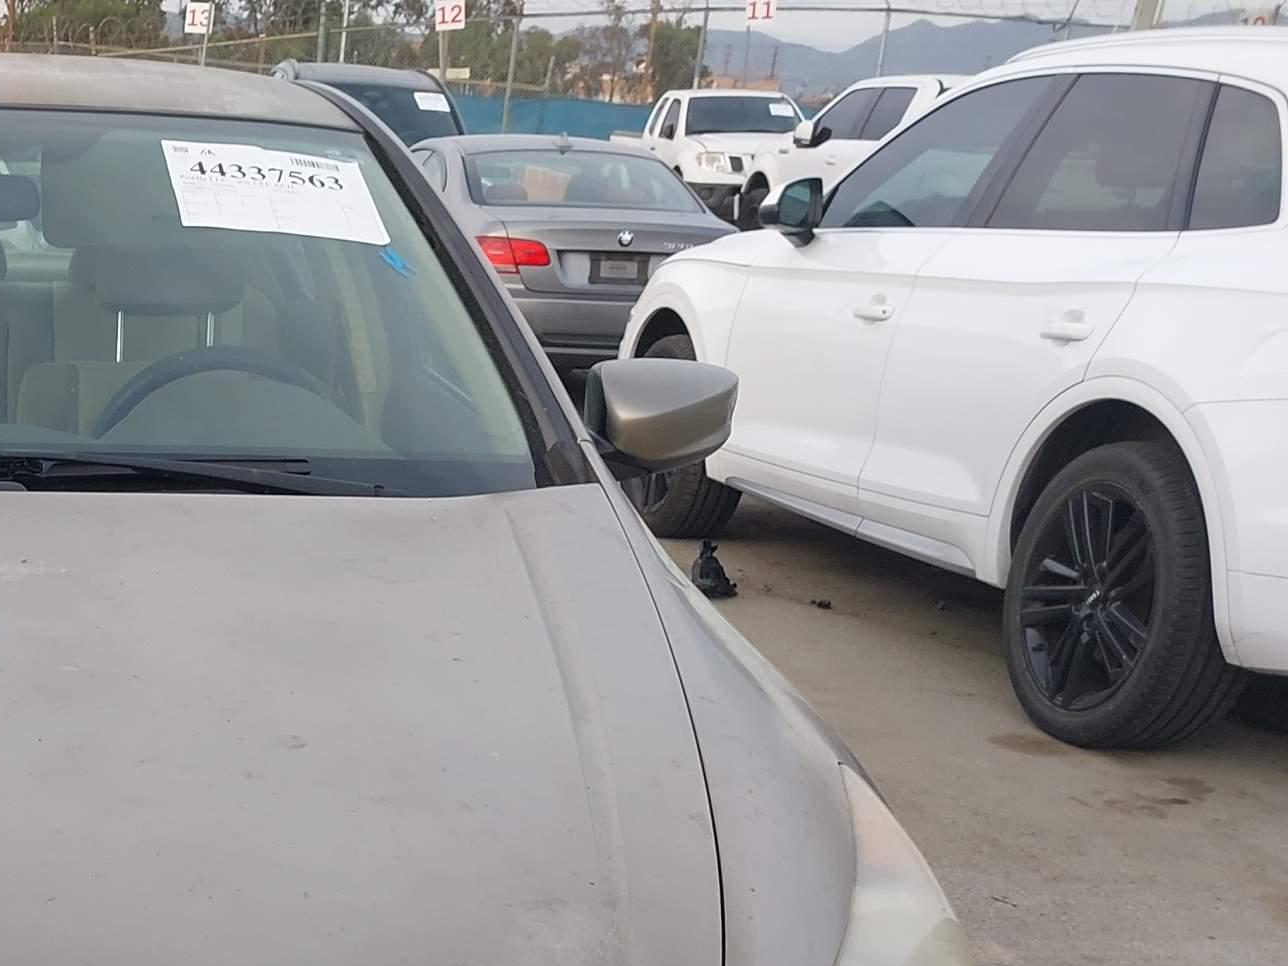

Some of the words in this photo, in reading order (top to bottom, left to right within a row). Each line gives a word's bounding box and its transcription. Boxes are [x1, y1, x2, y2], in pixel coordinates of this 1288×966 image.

[187, 8, 211, 27] 13
[438, 4, 463, 24] 12
[747, 1, 773, 20] 11
[190, 160, 344, 191] 44337563
